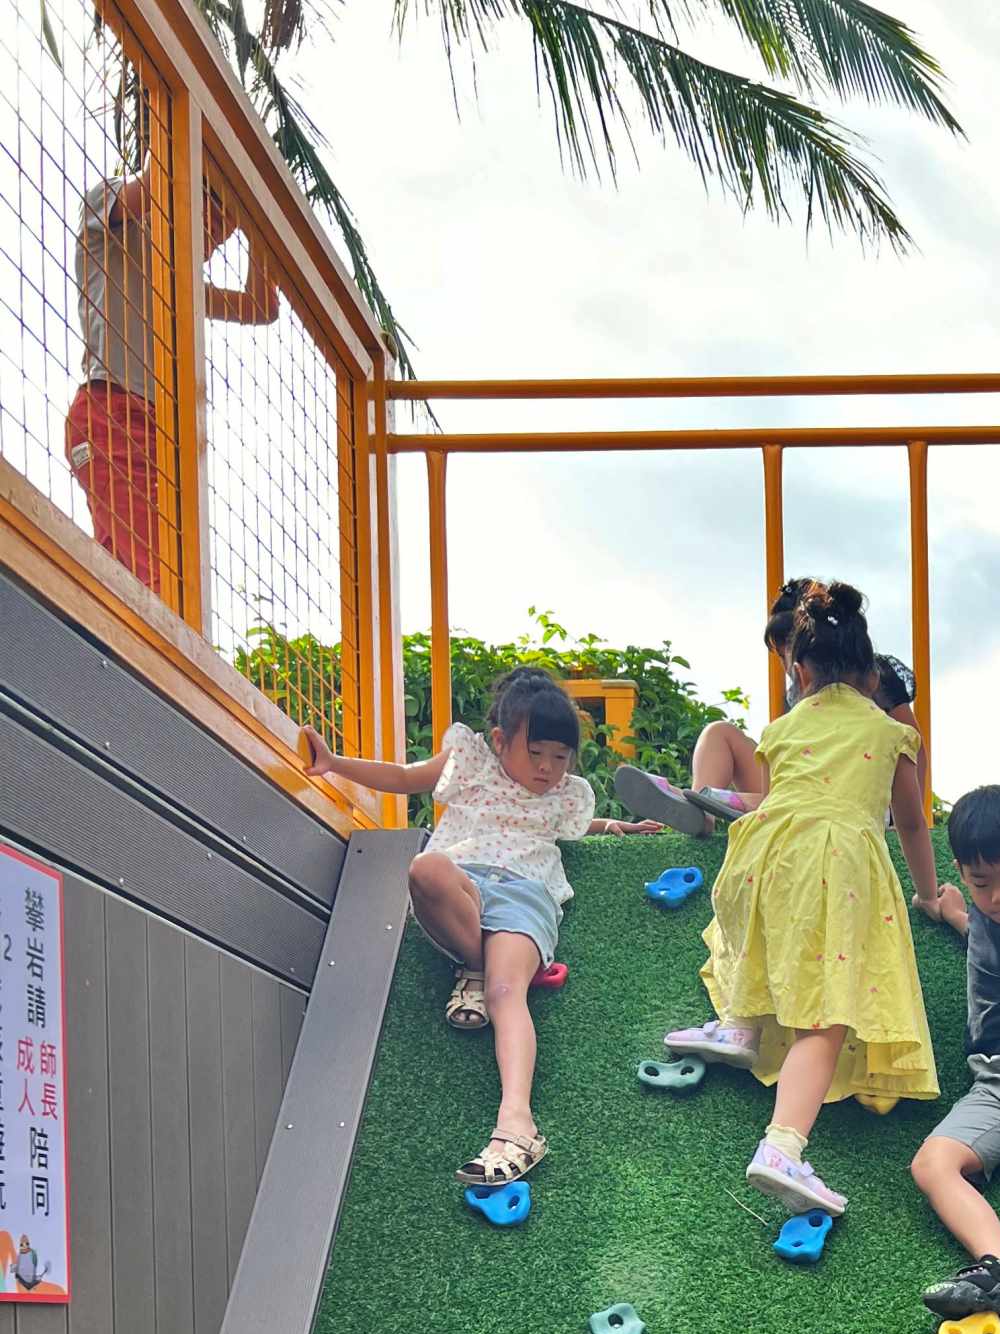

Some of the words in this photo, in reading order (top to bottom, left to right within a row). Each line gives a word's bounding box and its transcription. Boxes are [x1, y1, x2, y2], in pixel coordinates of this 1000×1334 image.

[24, 887, 47, 1028] 攀岩請
[16, 1036, 36, 1117] 成人
[39, 1040, 58, 1121] 師長
[29, 1126, 50, 1218] 陪同
